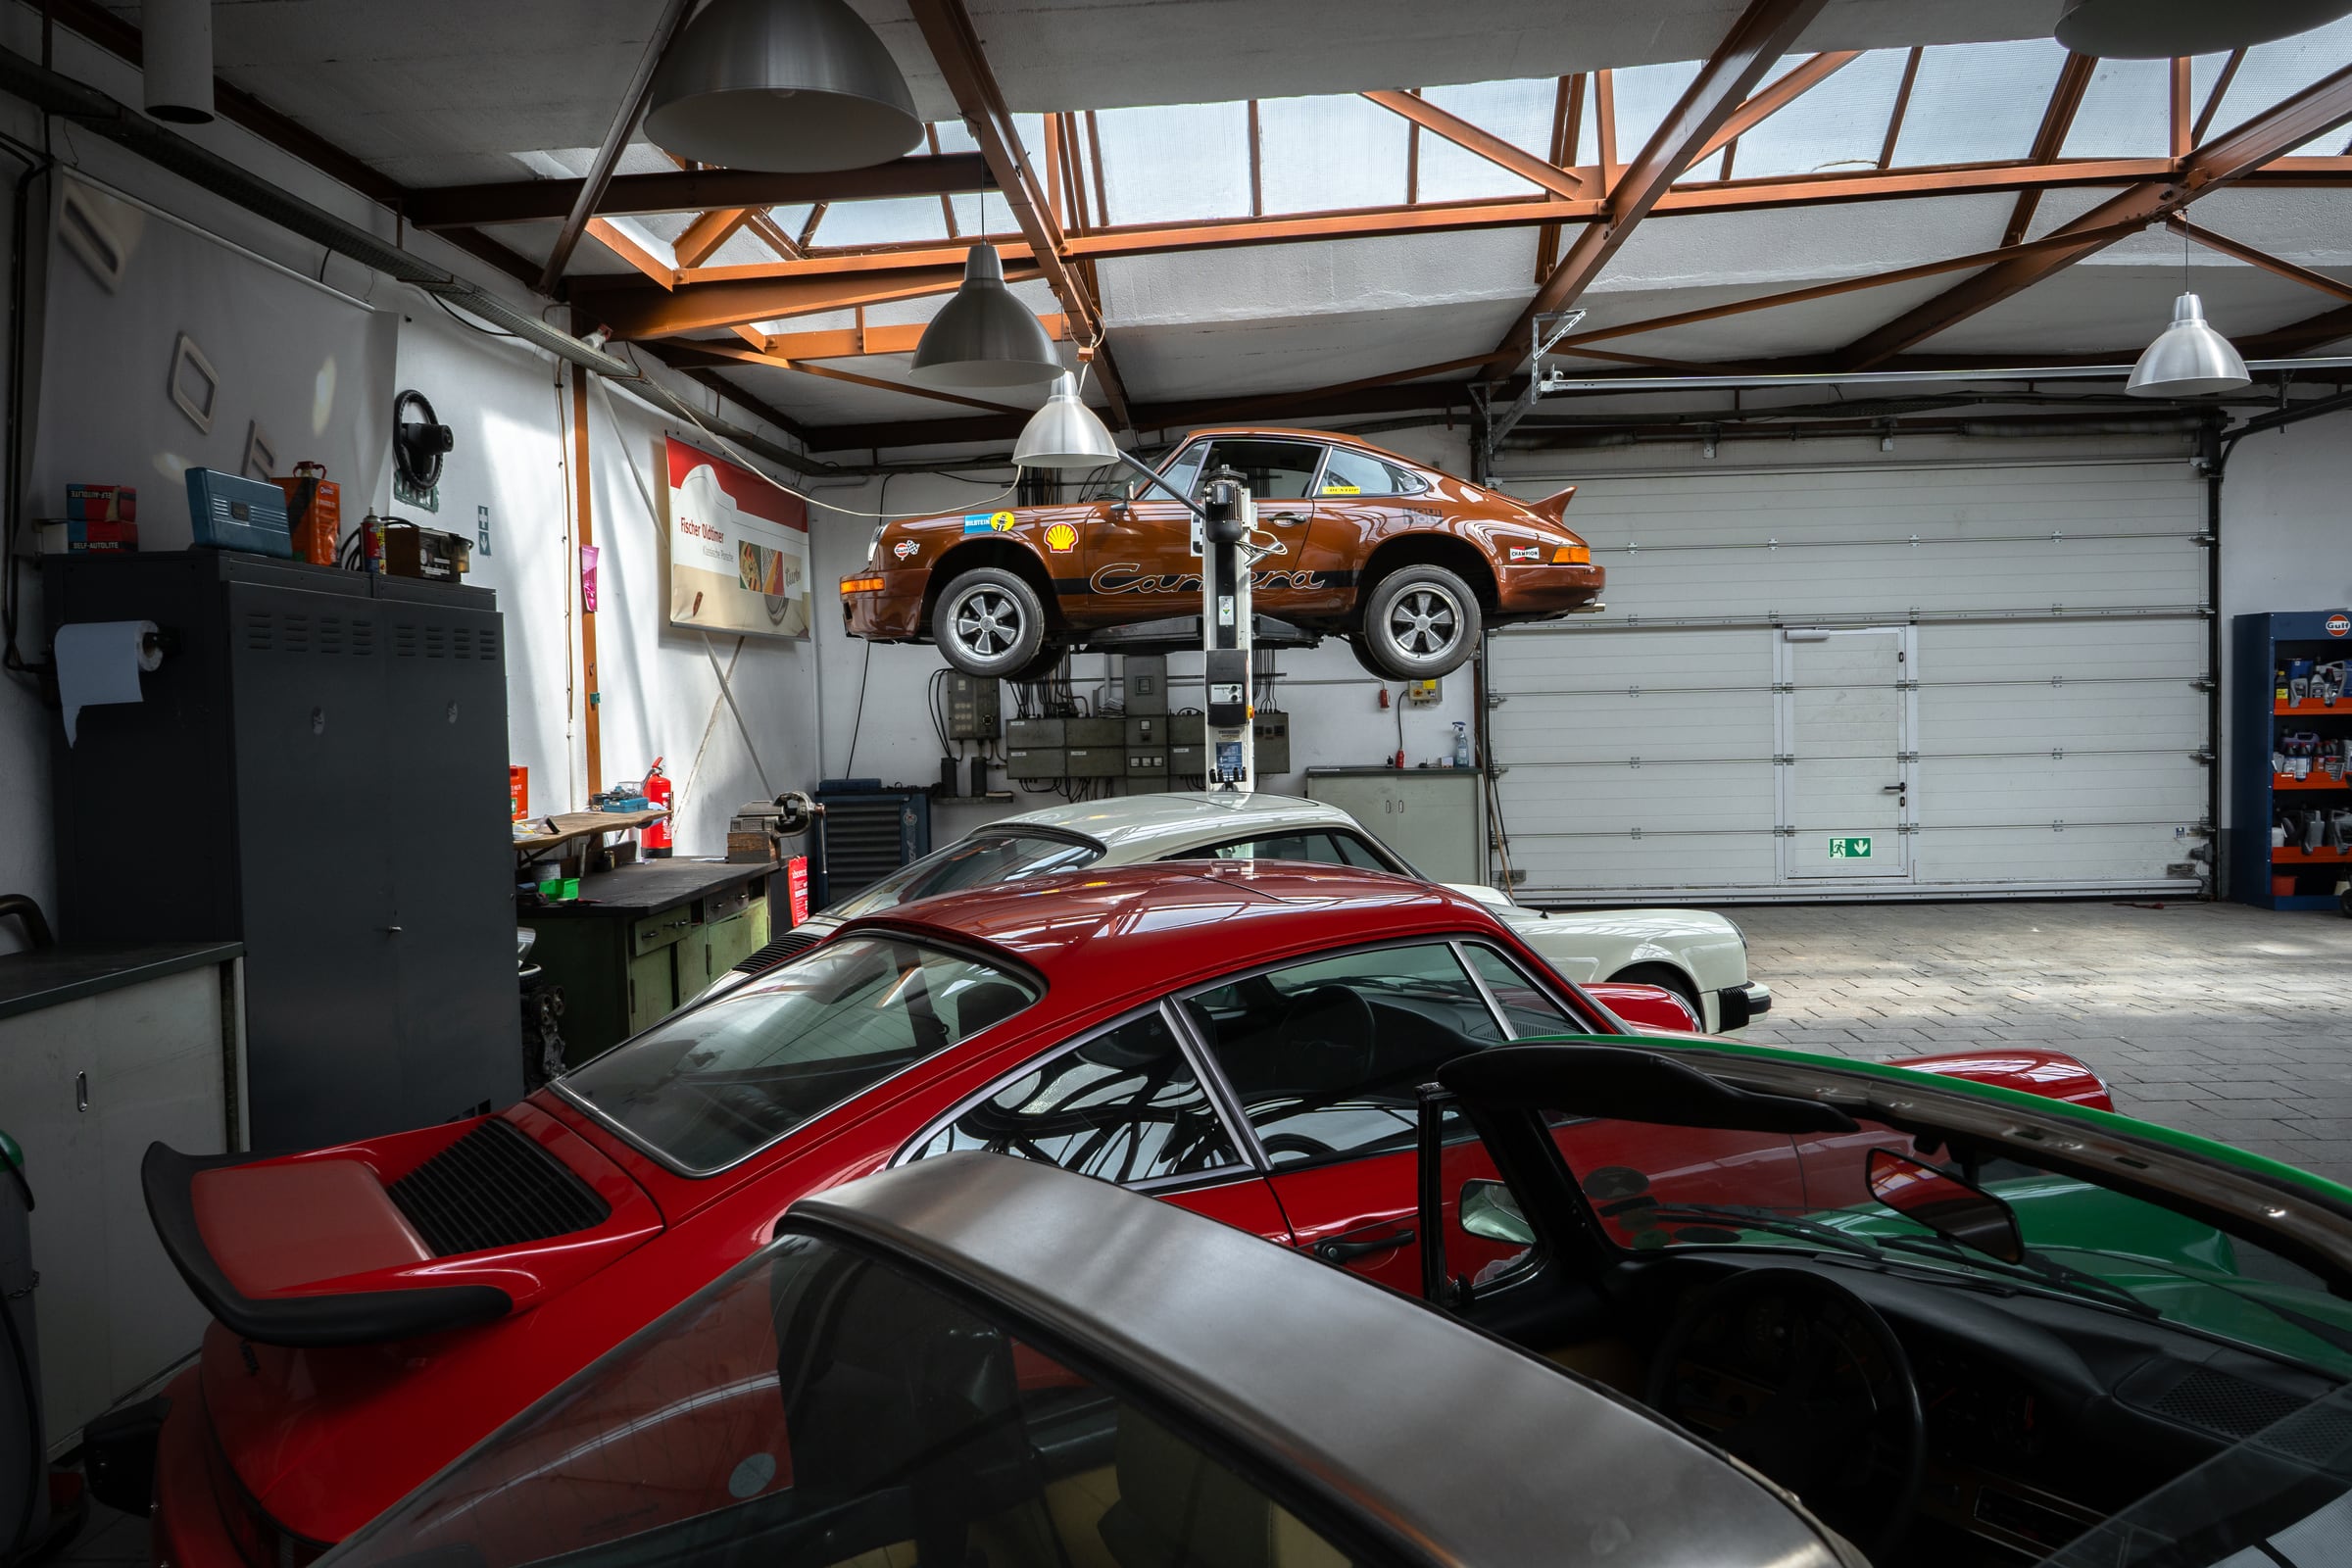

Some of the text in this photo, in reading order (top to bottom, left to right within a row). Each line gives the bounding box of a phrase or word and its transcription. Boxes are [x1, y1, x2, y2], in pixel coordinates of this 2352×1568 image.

[680, 516, 724, 544] Fischer Oldtimer
[1090, 563, 1326, 595] Carra
